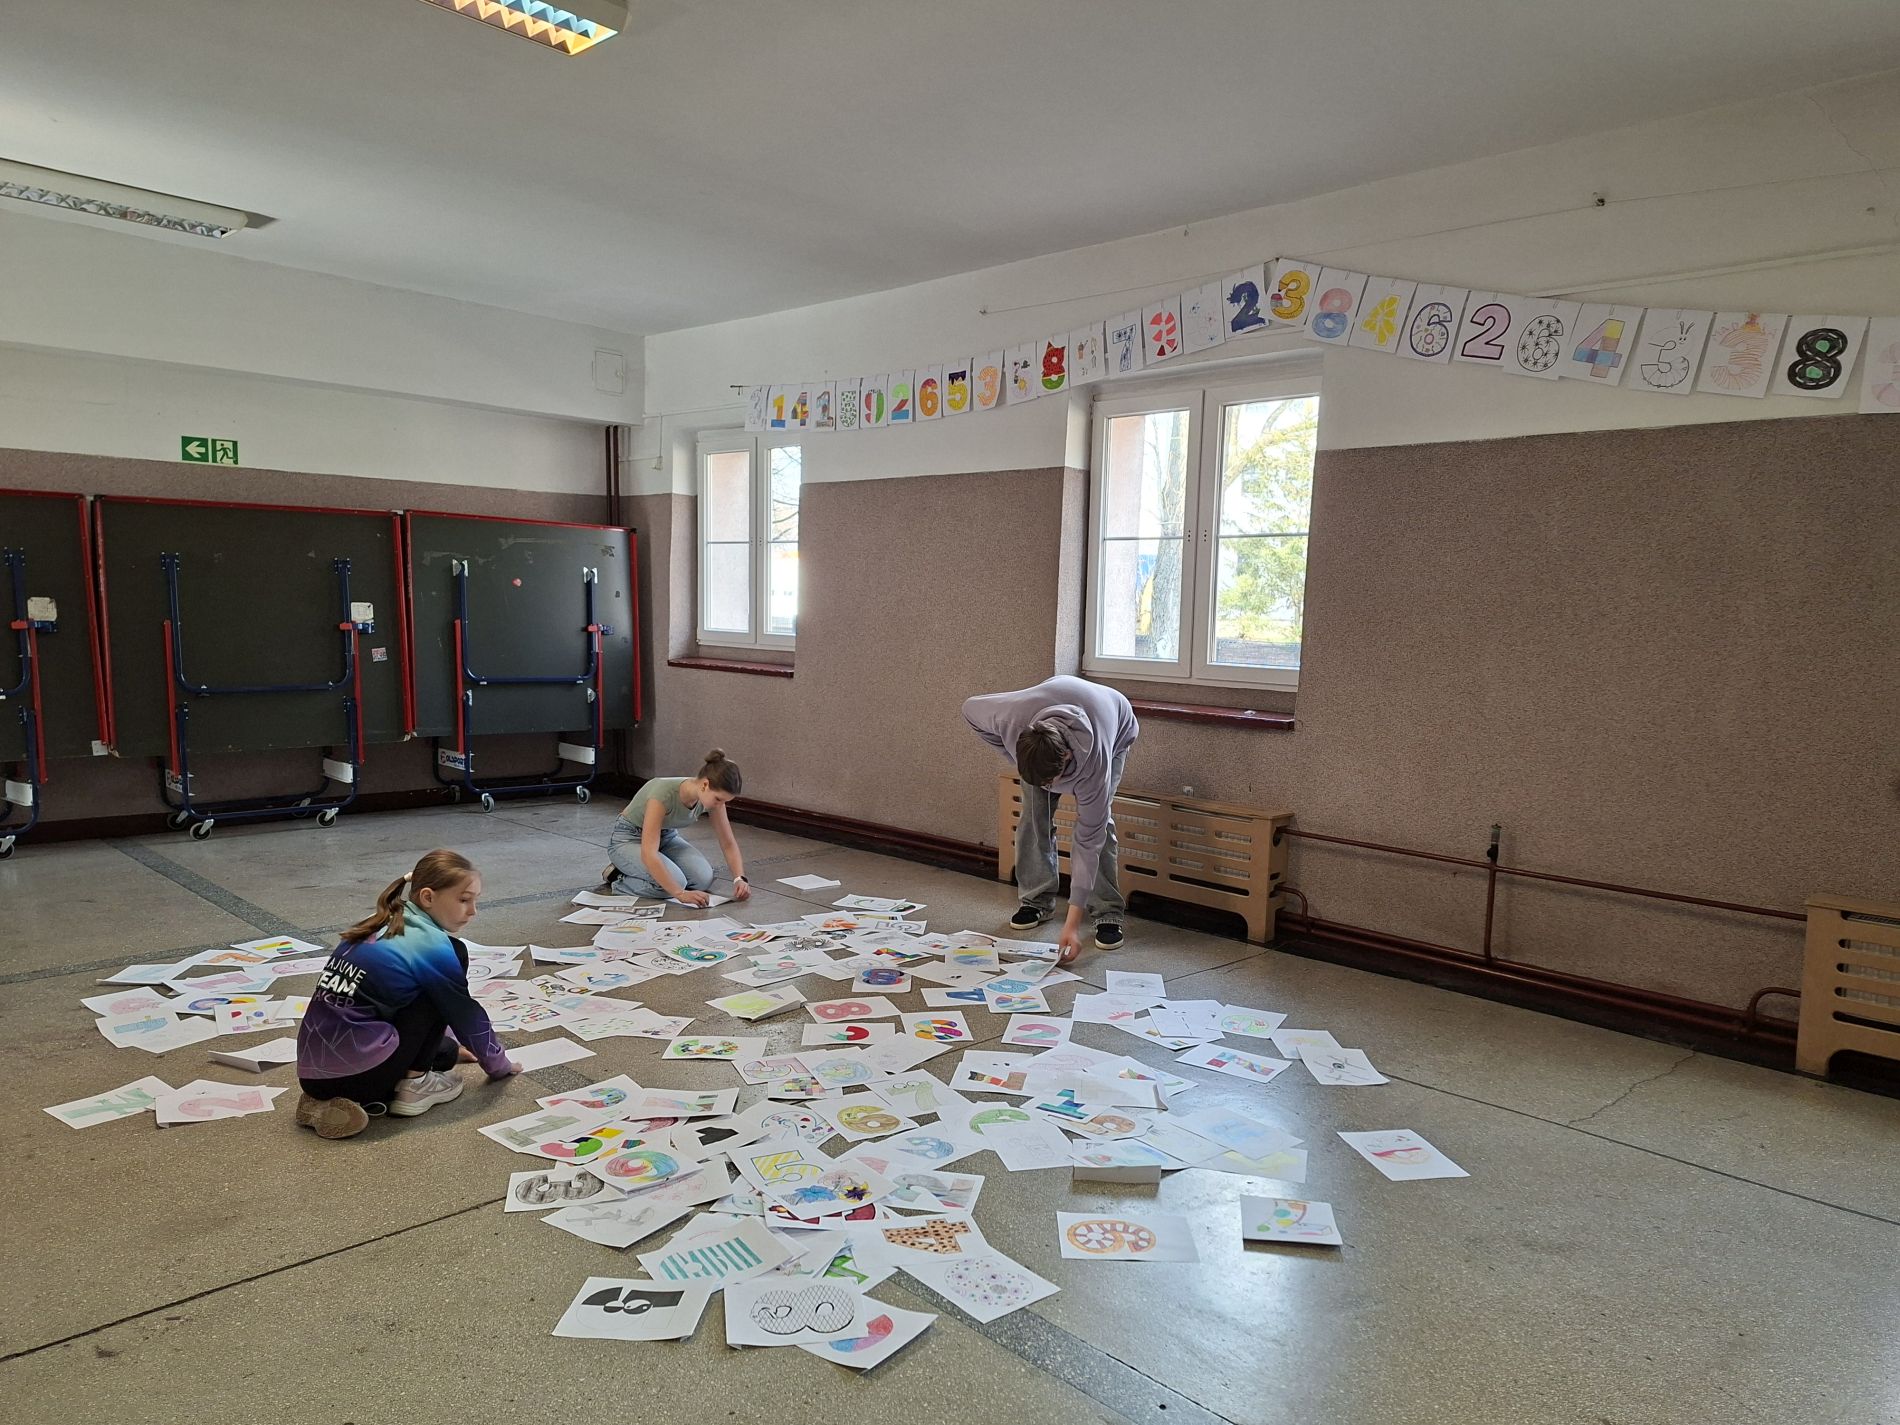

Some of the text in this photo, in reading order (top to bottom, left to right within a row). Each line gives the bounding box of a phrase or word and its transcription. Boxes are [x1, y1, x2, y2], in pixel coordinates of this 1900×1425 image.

[771, 394, 786, 428] 1
[791, 391, 809, 426] 4
[816, 391, 834, 428] 1
[891, 384, 910, 420] 2
[918, 378, 939, 417] 6
[947, 370, 968, 410] 5
[977, 366, 998, 407] 3
[1041, 340, 1067, 390] 8
[1112, 324, 1136, 372] 7
[1226, 281, 1266, 332] 2
[1270, 270, 1311, 320] 3
[1312, 288, 1354, 339] 8
[1361, 295, 1401, 346] 4
[1409, 302, 1452, 357] 6
[1461, 303, 1511, 361] 2
[1517, 315, 1564, 372] 6
[1573, 319, 1623, 378] 4
[1710, 328, 1769, 390] 3
[1787, 328, 1849, 391] 8
[1011, 1023, 1061, 1047] 2
